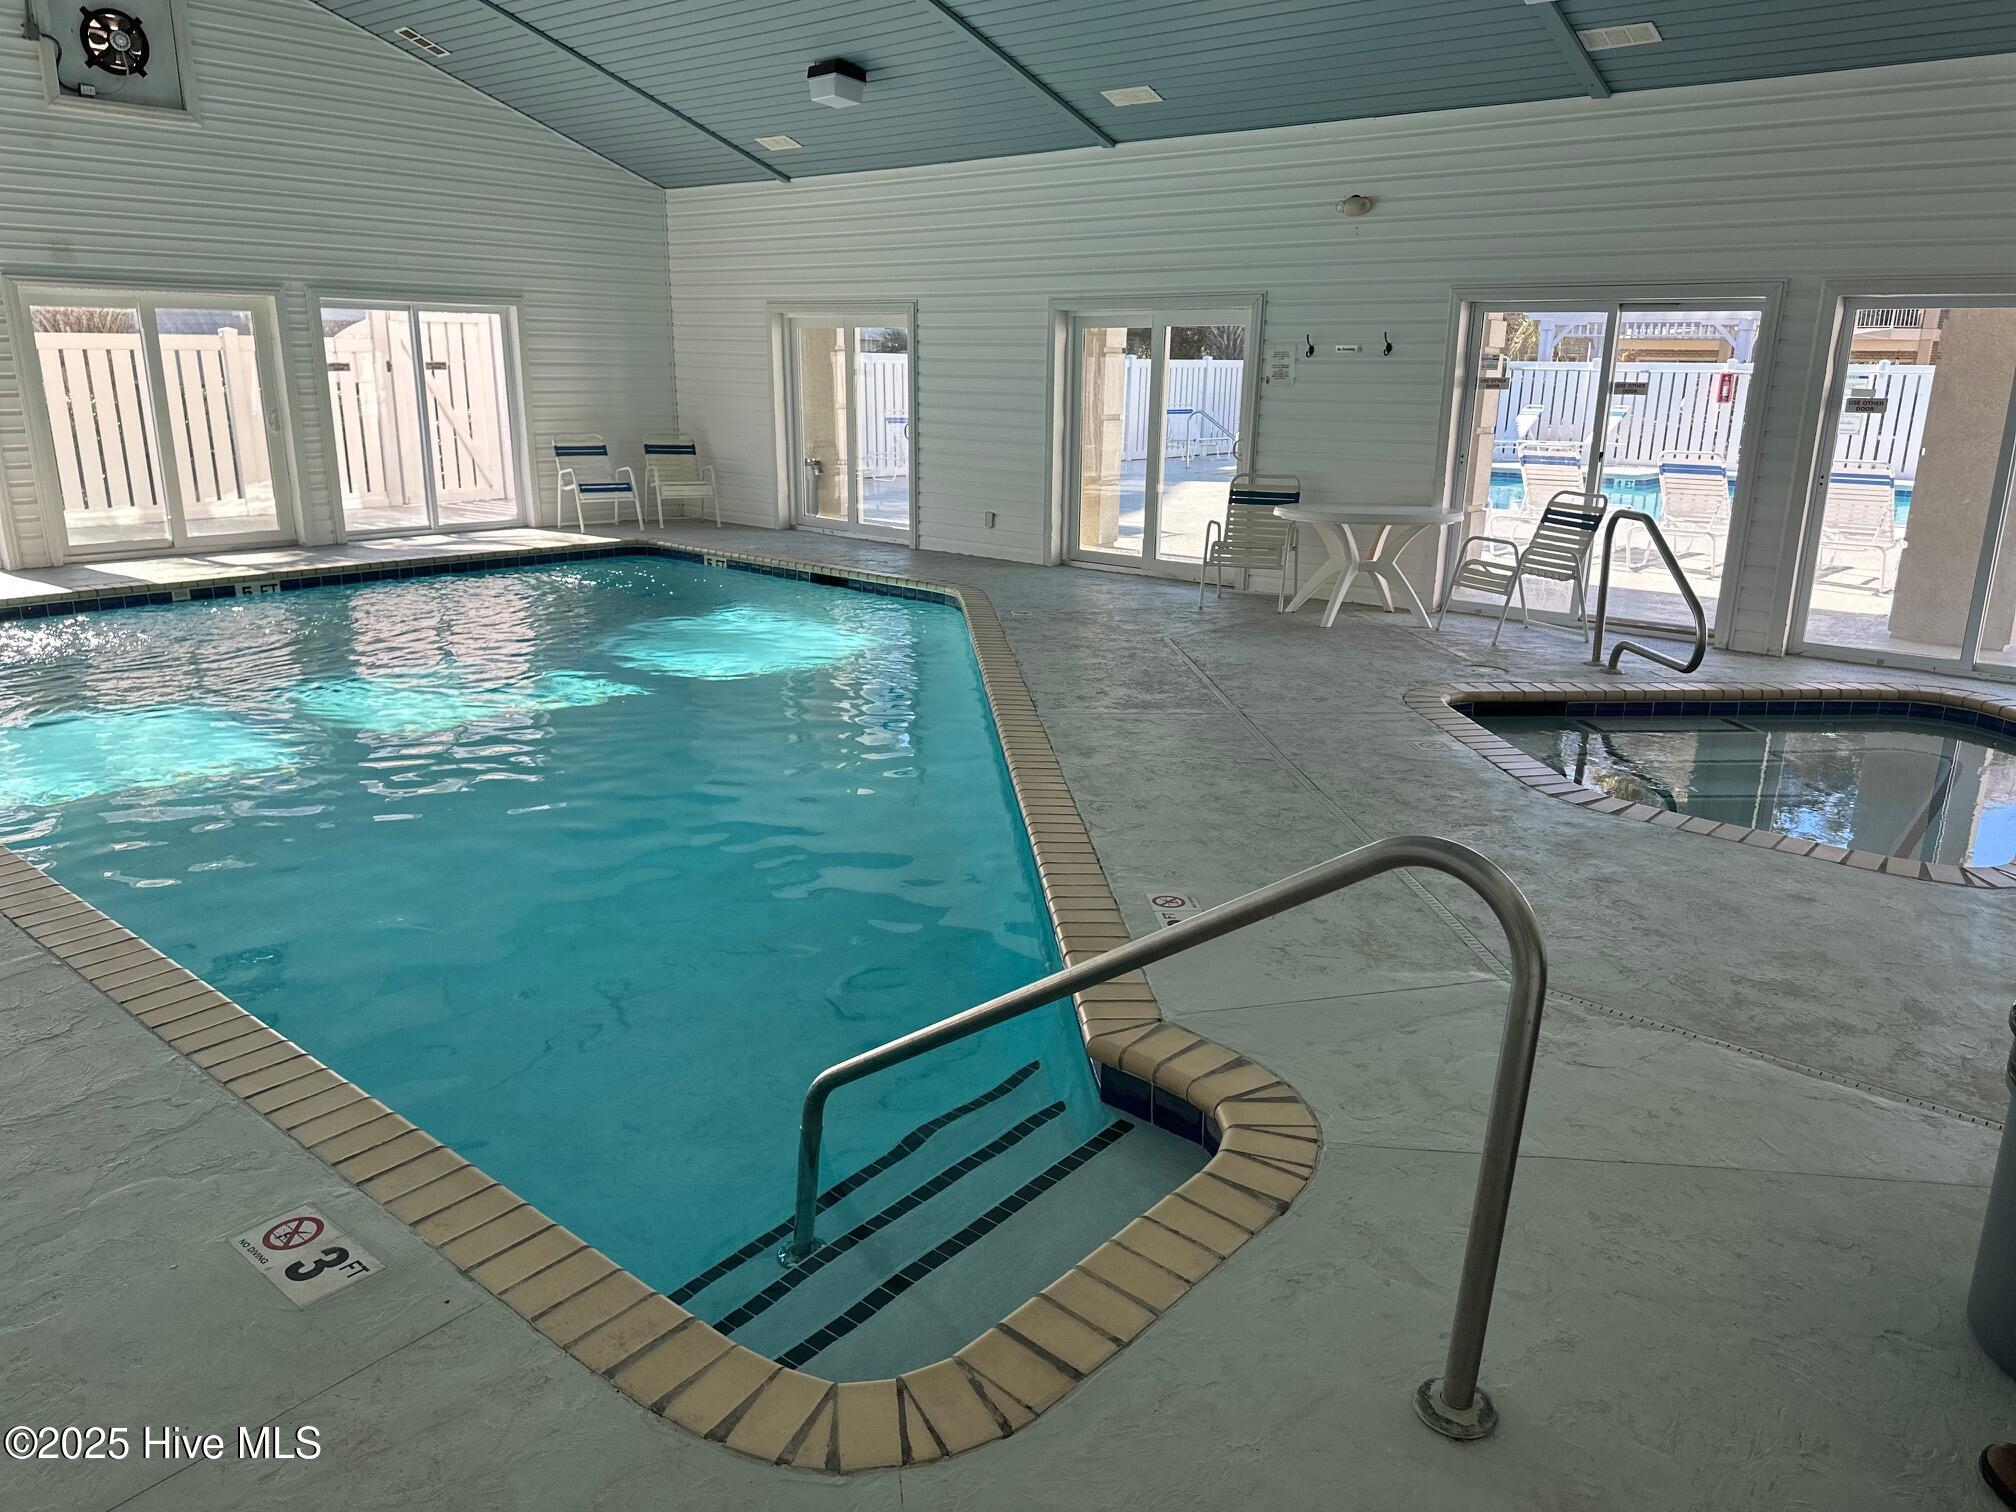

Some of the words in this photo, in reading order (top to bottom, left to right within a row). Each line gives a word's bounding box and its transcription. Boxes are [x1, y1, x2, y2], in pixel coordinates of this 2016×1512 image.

[242, 586, 253, 595] 5
[260, 583, 278, 594] FT
[238, 1238, 251, 1248] NO
[247, 1246, 269, 1265] DIVING
[285, 1246, 350, 1282] 3
[338, 1259, 370, 1279] FT
